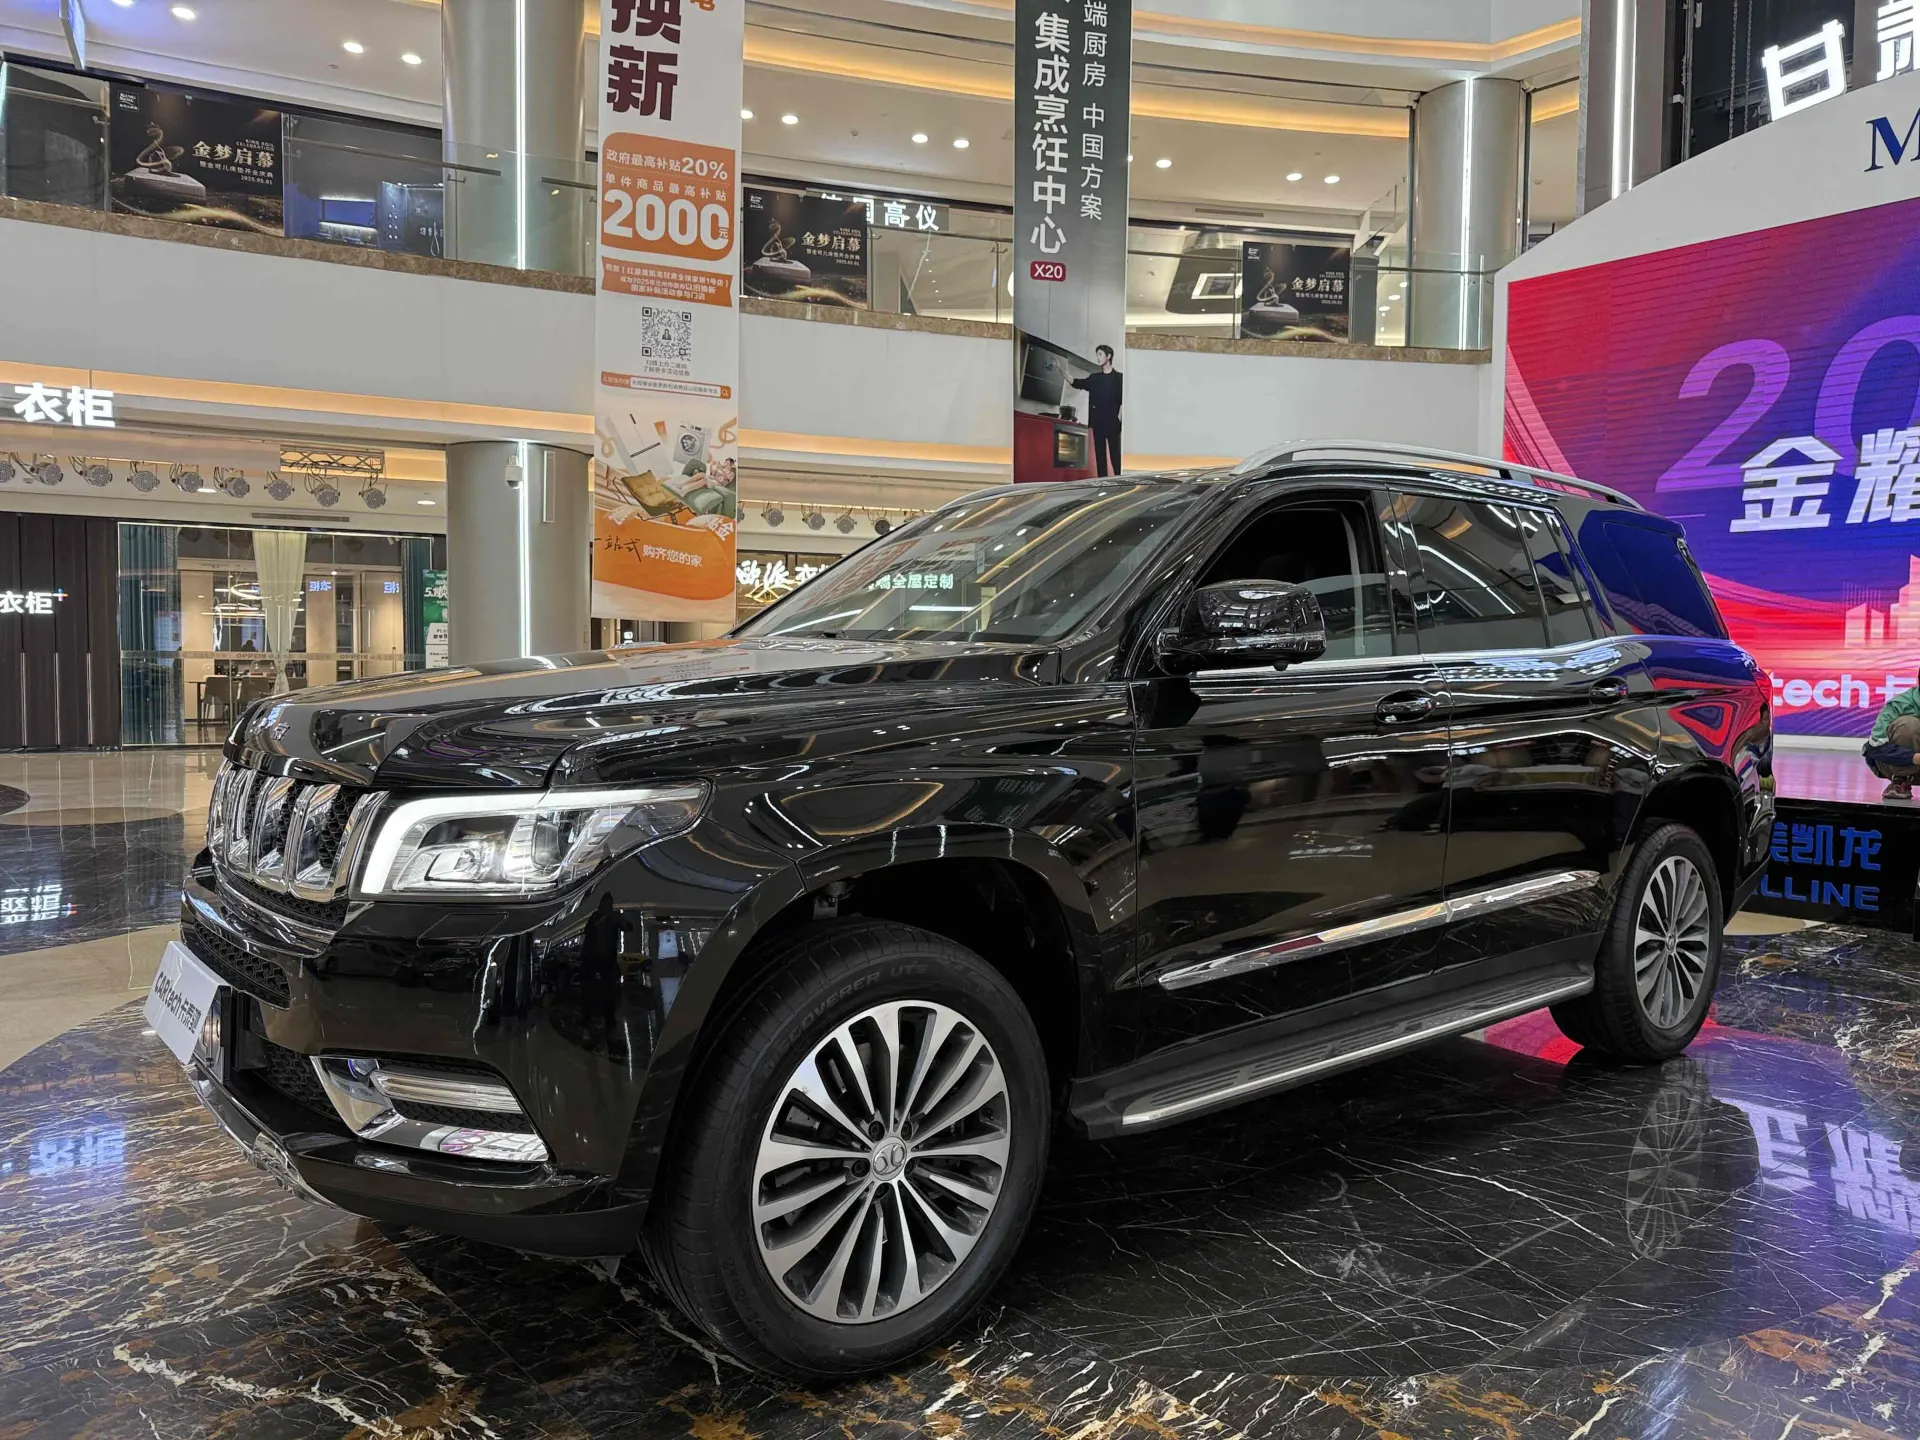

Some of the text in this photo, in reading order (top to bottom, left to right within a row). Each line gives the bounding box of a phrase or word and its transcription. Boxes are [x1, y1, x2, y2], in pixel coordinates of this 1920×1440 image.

[607, 0, 681, 121] 换新
[1030, 12, 1070, 254] 集成烹饪中心
[192, 140, 274, 168] 金梦启幕
[606, 148, 728, 180] 政府最高补贴20%
[1080, 102, 1104, 220] 中国方案
[605, 172, 727, 202] 单件商品最高补贴
[801, 231, 861, 252] 金梦启幕
[1034, 264, 1063, 279] X20
[1291, 276, 1344, 292] 金梦启幕
[13, 382, 116, 427] 衣柜
[643, 544, 703, 568] 购齐您的家
[1751, 874, 1880, 911] LLINE
